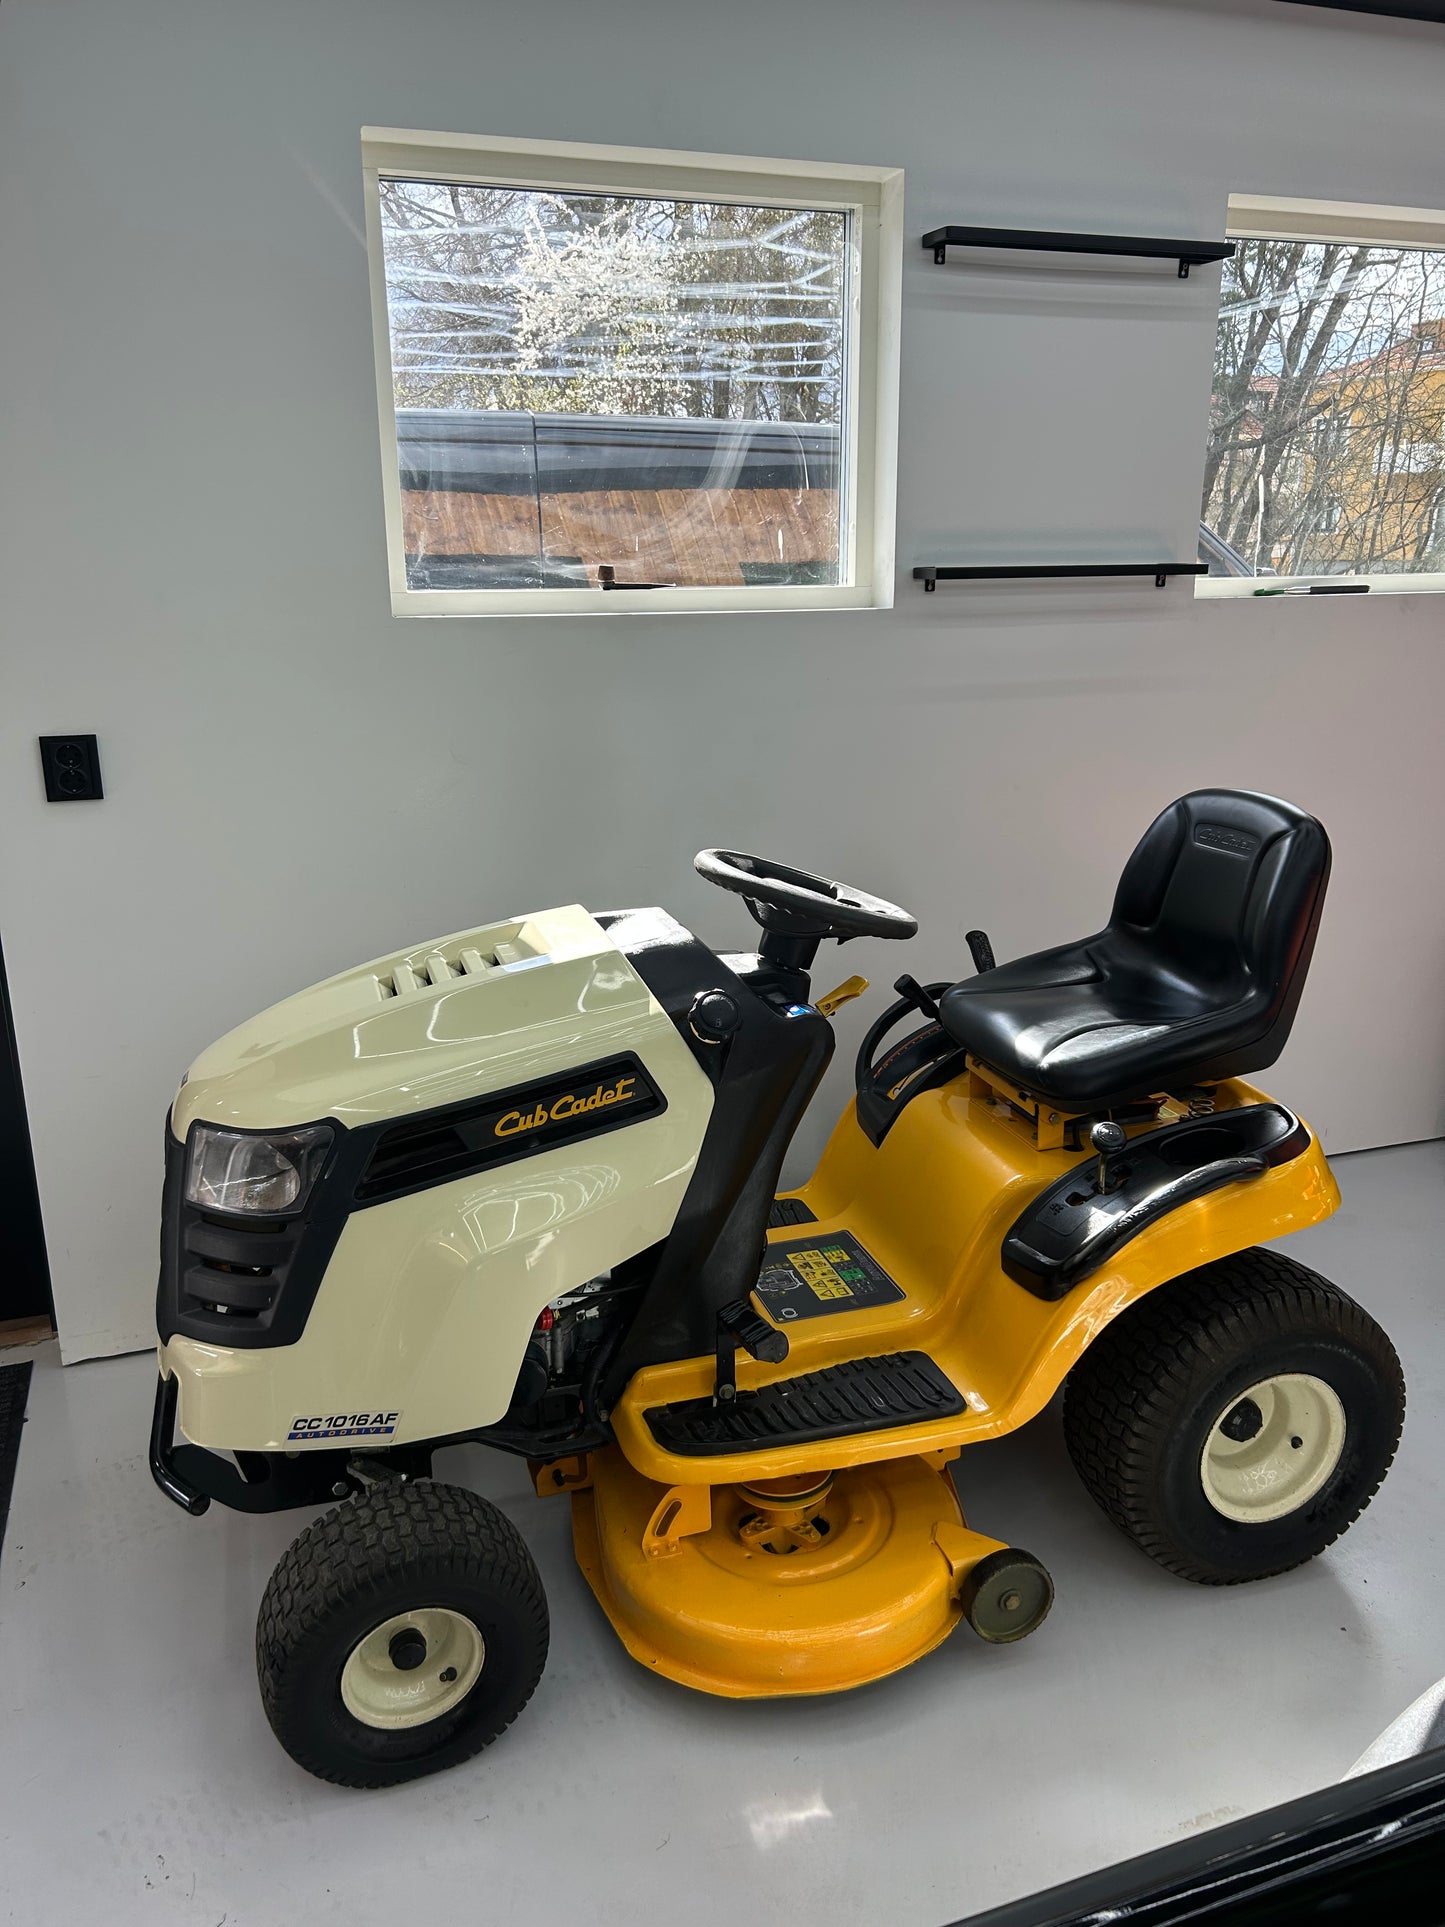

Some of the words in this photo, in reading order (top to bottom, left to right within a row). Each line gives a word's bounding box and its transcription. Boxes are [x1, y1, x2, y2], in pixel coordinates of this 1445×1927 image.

[494, 1104, 548, 1137] Cub
[550, 1078, 636, 1120] Cadet
[296, 1427, 386, 1438] AUTODRIVE
